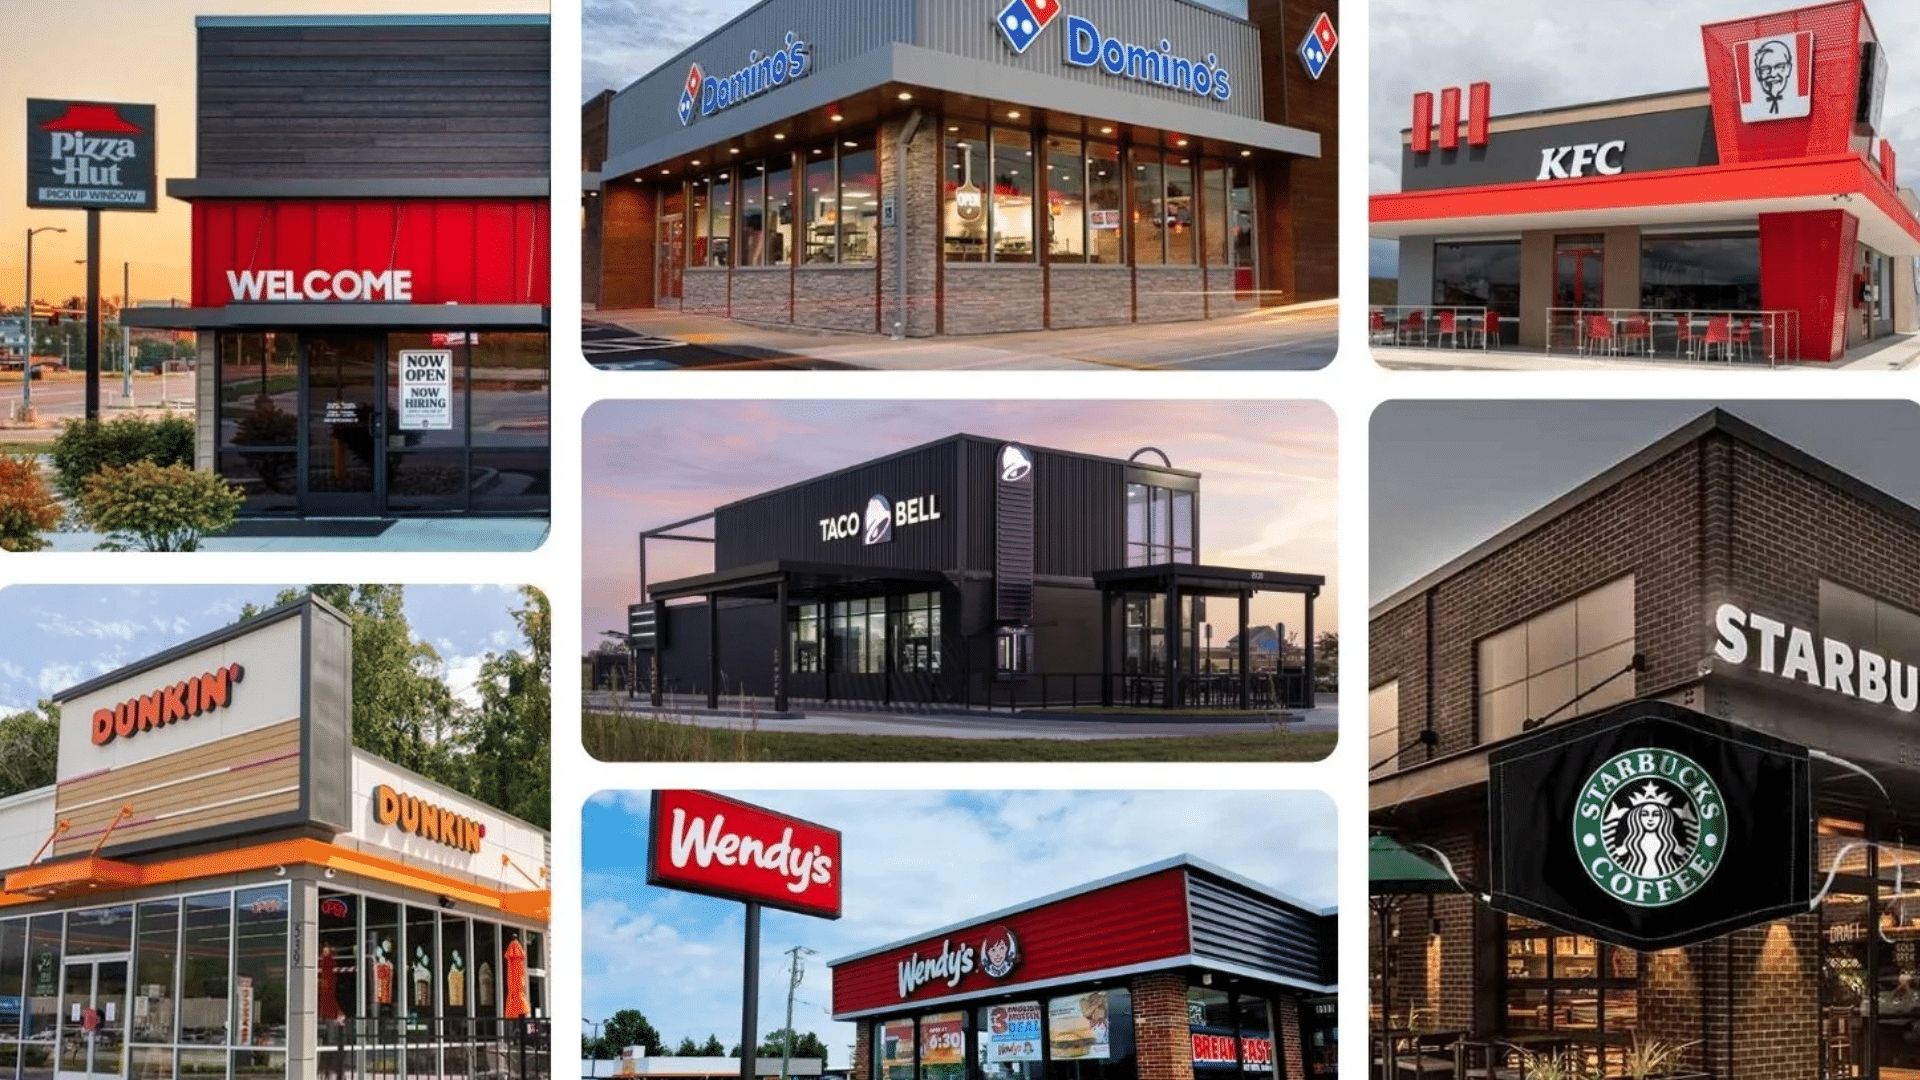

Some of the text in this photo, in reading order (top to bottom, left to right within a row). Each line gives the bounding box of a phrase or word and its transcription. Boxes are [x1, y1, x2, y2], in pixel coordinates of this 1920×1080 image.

[702, 31, 805, 116] Domino's
[1067, 15, 1231, 100] Domino's
[50, 131, 136, 161] Pizza
[1536, 140, 1625, 181] KFC
[52, 156, 123, 186] Hut
[46, 190, 138, 200] PICK UP WINDOW
[226, 269, 412, 300] WELCOME
[405, 369, 445, 381] OPEN
[407, 355, 444, 367] NOW
[405, 398, 446, 408] HIRING
[411, 388, 440, 397] NOW
[820, 494, 940, 542] TACO BELL
[1715, 603, 1918, 712] STARBU
[91, 662, 245, 746] DUNKIN'
[1581, 753, 1720, 821] STARBUCKS
[373, 784, 485, 854] DUNKIN'
[671, 807, 832, 893] Wendy's
[1591, 854, 1714, 901] COFFEE
[899, 939, 974, 998] Wendy's
[929, 1032, 960, 1048] 6:30
[991, 1007, 1008, 1034] 3
